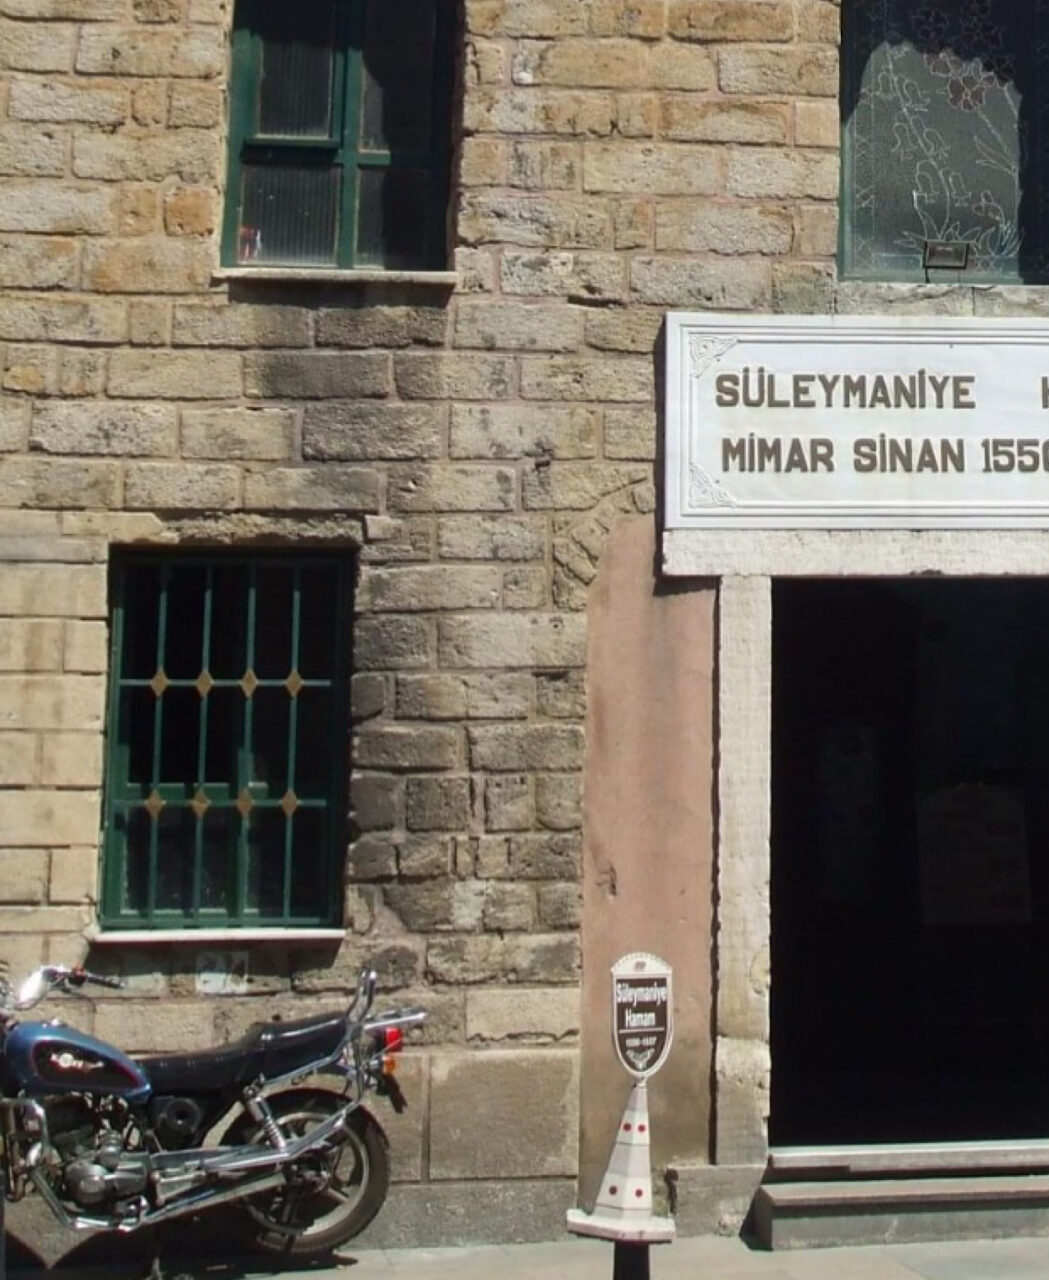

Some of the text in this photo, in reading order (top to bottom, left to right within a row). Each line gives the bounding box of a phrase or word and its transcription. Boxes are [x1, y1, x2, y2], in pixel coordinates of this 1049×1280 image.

[715, 367, 976, 410] SÜLEYMANİYE
[721, 432, 835, 474] MİMAR
[853, 433, 965, 474] SİNAN
